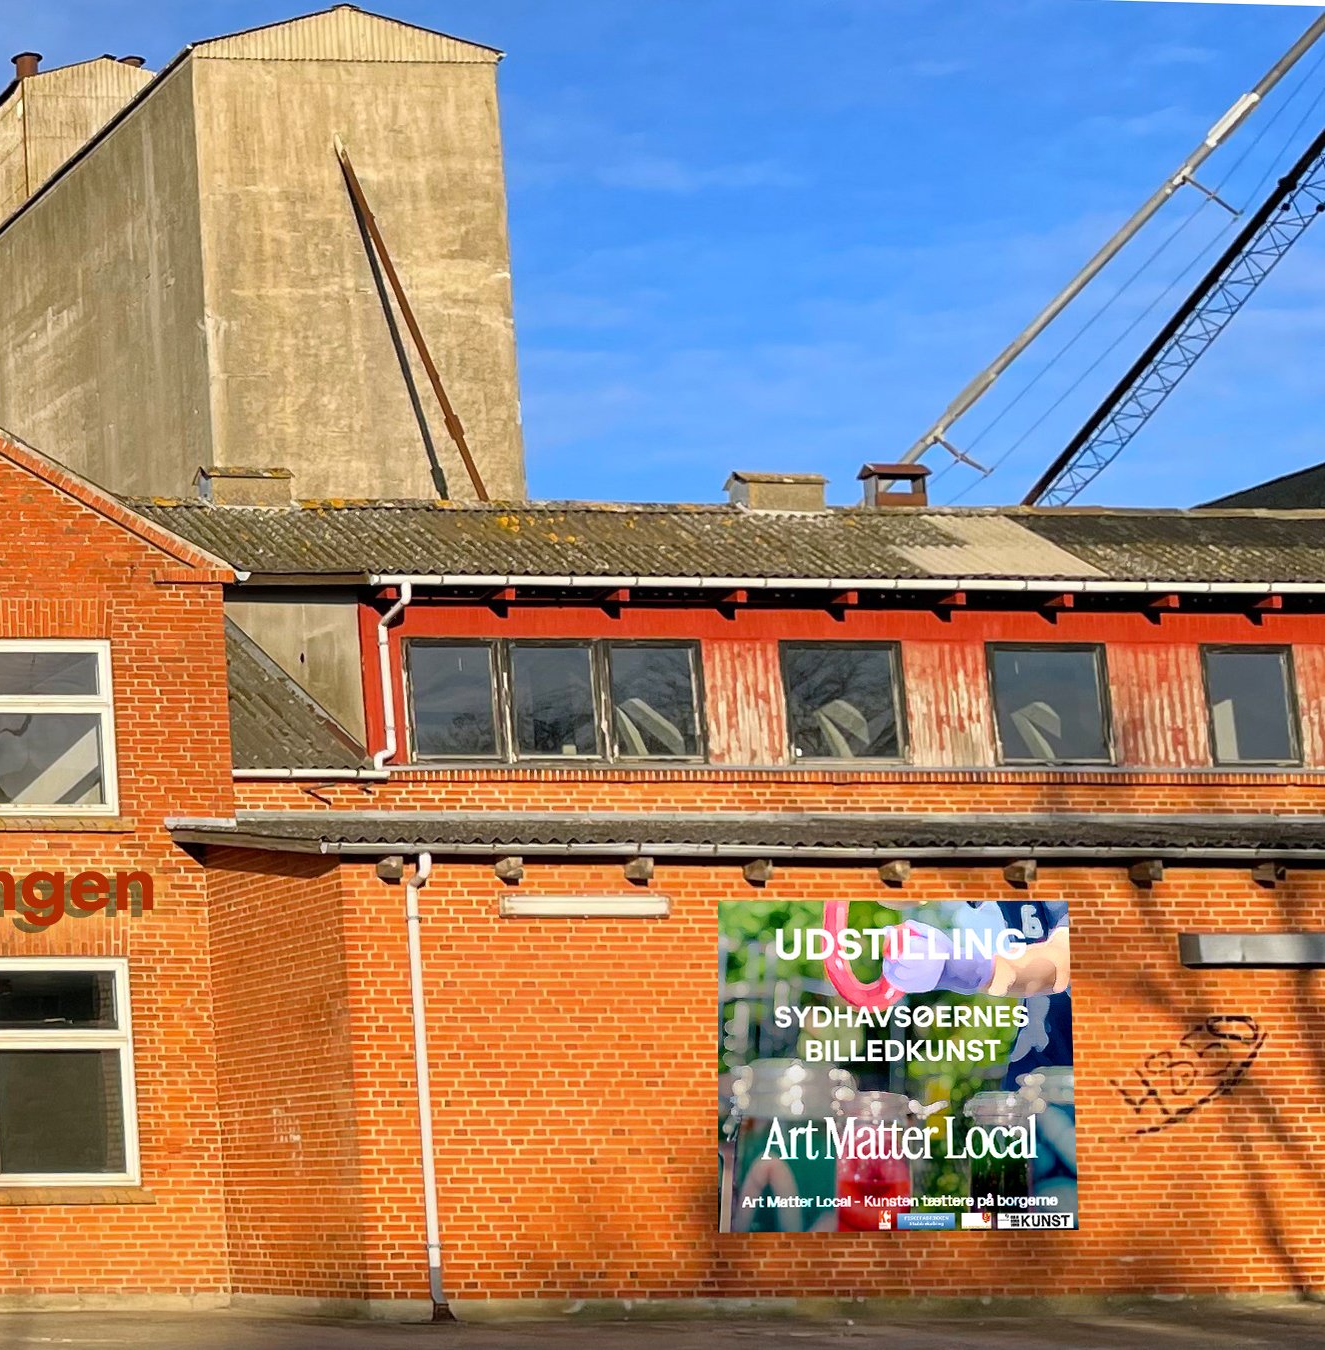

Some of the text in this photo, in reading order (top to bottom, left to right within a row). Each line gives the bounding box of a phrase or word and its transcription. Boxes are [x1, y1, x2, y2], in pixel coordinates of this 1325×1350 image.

[774, 927, 1027, 961] UDSTILLING
[773, 1004, 1030, 1028] SYDHAVSØERNES
[804, 1038, 1001, 1062] BILLEDKUNST
[760, 1113, 1039, 1160] Art Matter Local
[741, 1195, 764, 1208] Art
[766, 1195, 814, 1208] Matter
[816, 1195, 852, 1208] Local
[864, 1195, 919, 1208] Kunsten
[921, 1194, 974, 1207] tættere
[977, 1192, 995, 1209] på
[997, 1194, 1059, 1209] borgerne
[1021, 1214, 1071, 1228] KUNST
